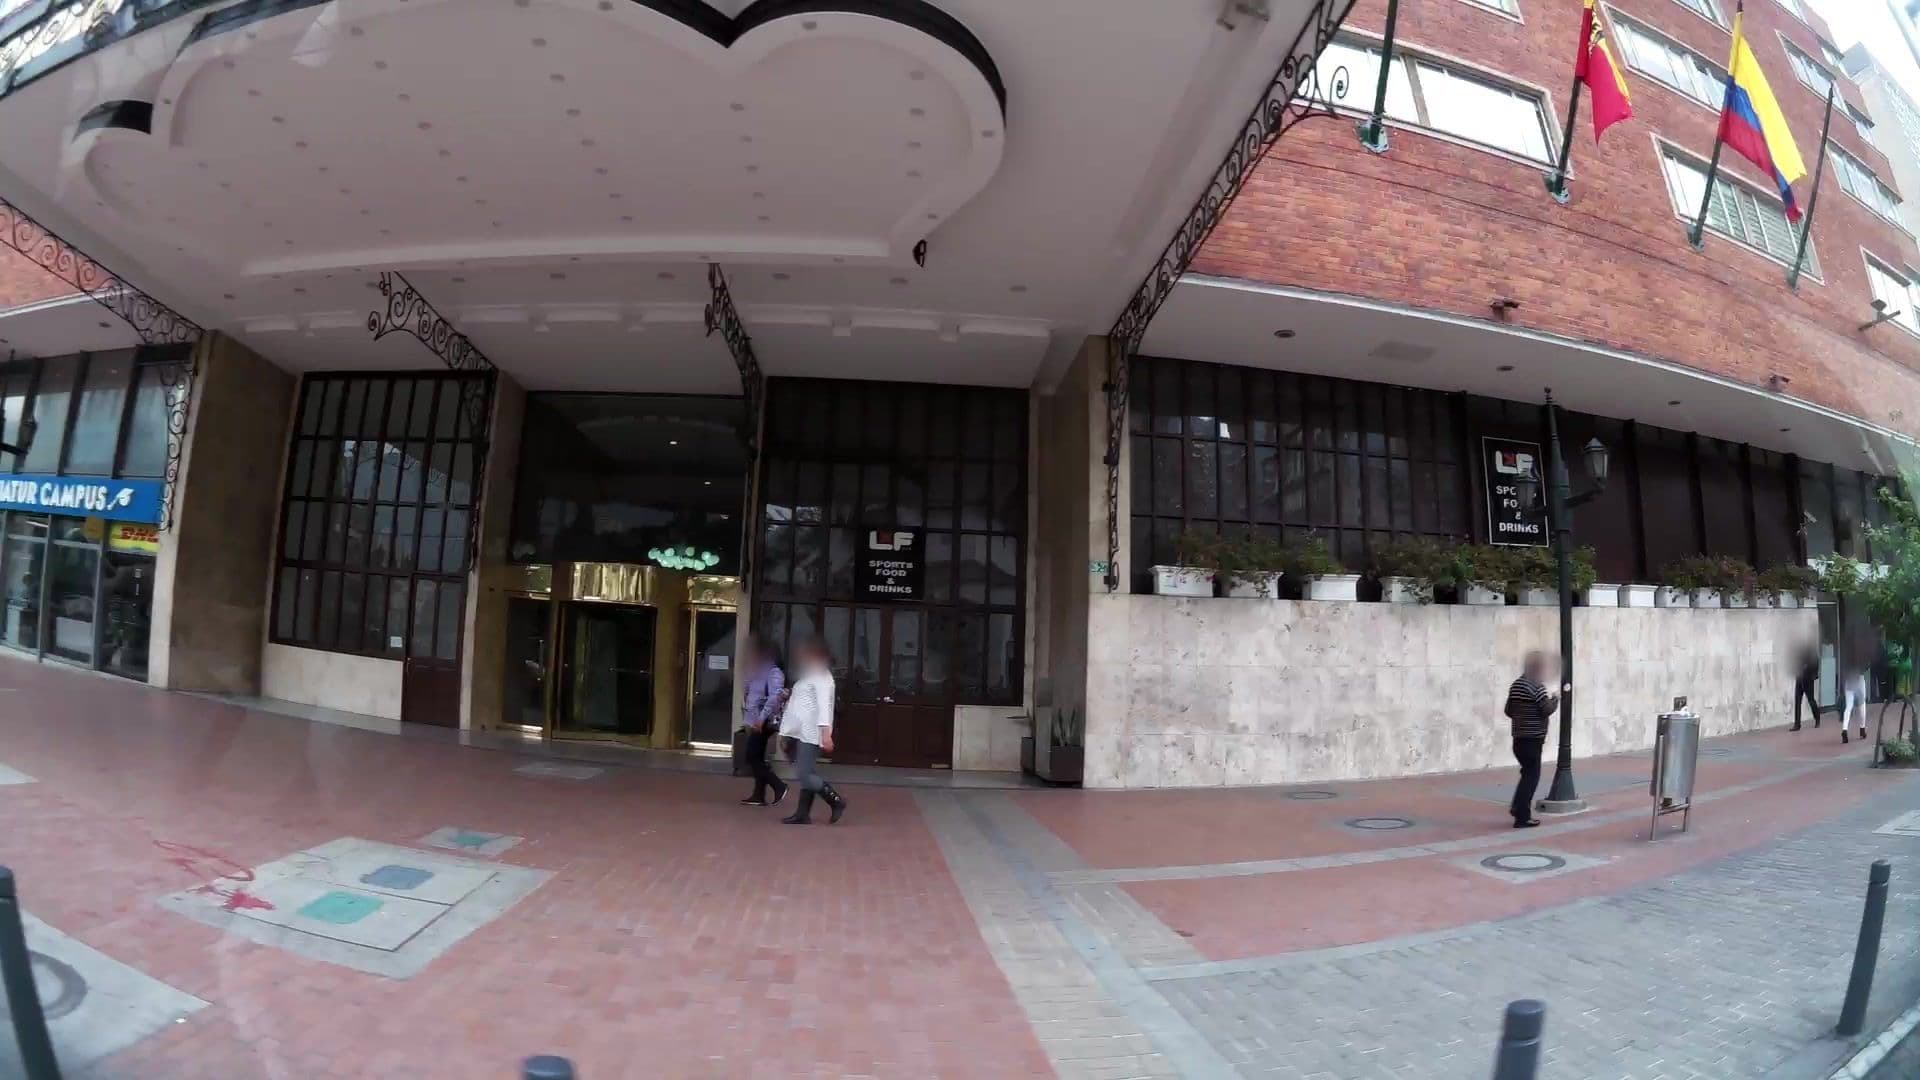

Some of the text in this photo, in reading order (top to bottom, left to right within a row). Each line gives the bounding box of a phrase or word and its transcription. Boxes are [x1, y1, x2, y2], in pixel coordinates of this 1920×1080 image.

[40, 482, 108, 511] CAMPUS
[1499, 522, 1539, 534] DRINKS
[869, 530, 914, 551] LF
[868, 560, 914, 569] SPORTS
[875, 568, 907, 577] FOOD
[886, 577, 895, 585] &
[869, 584, 913, 594] DRINKS
